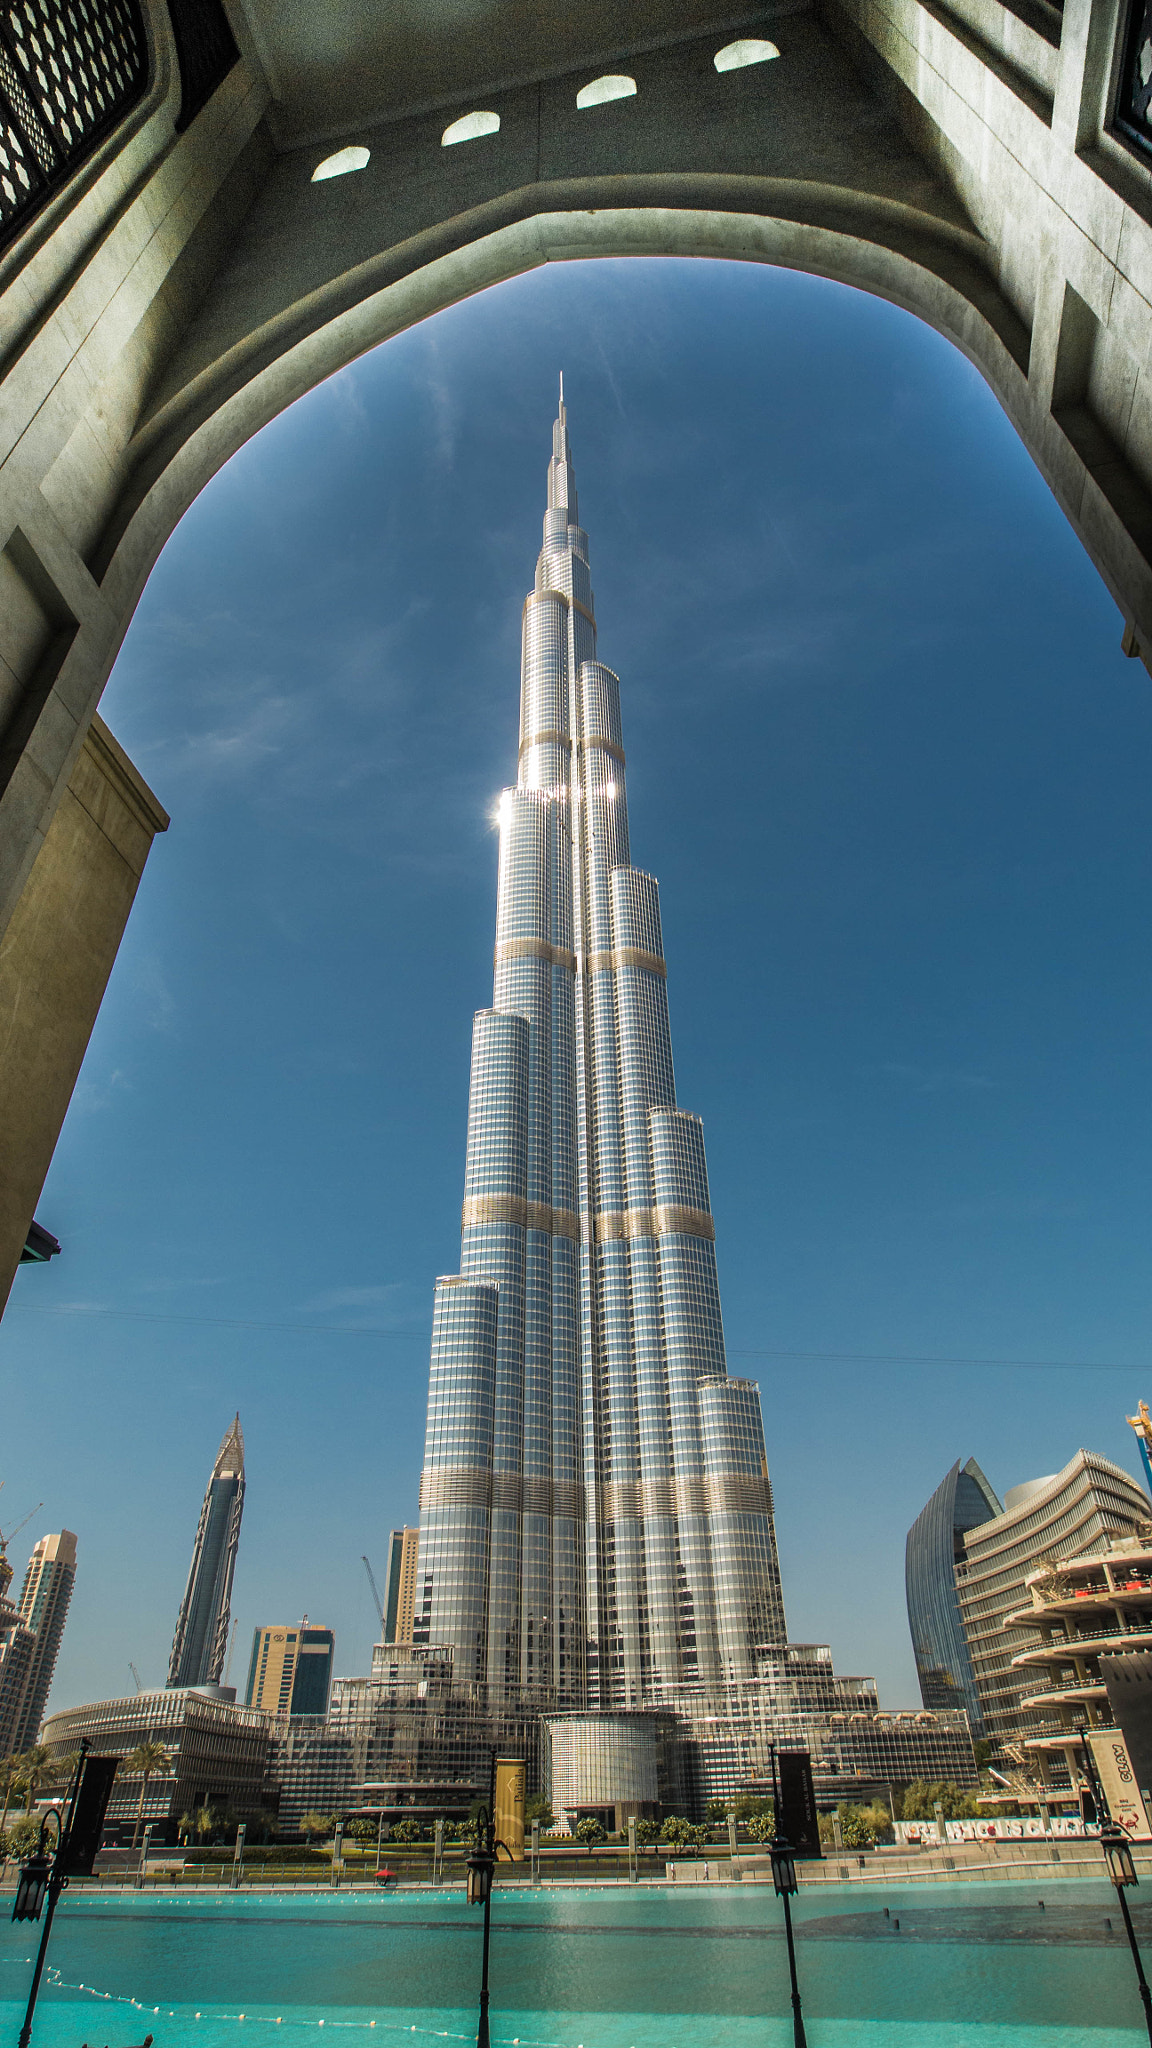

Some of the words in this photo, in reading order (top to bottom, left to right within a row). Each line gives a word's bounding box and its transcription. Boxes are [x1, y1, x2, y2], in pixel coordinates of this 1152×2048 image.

[1112, 1744, 1132, 1783] CLAW
[514, 1768, 524, 1802] Patiala
[945, 1819, 1002, 1839] ASHION
[1004, 1818, 1022, 1838] IS
